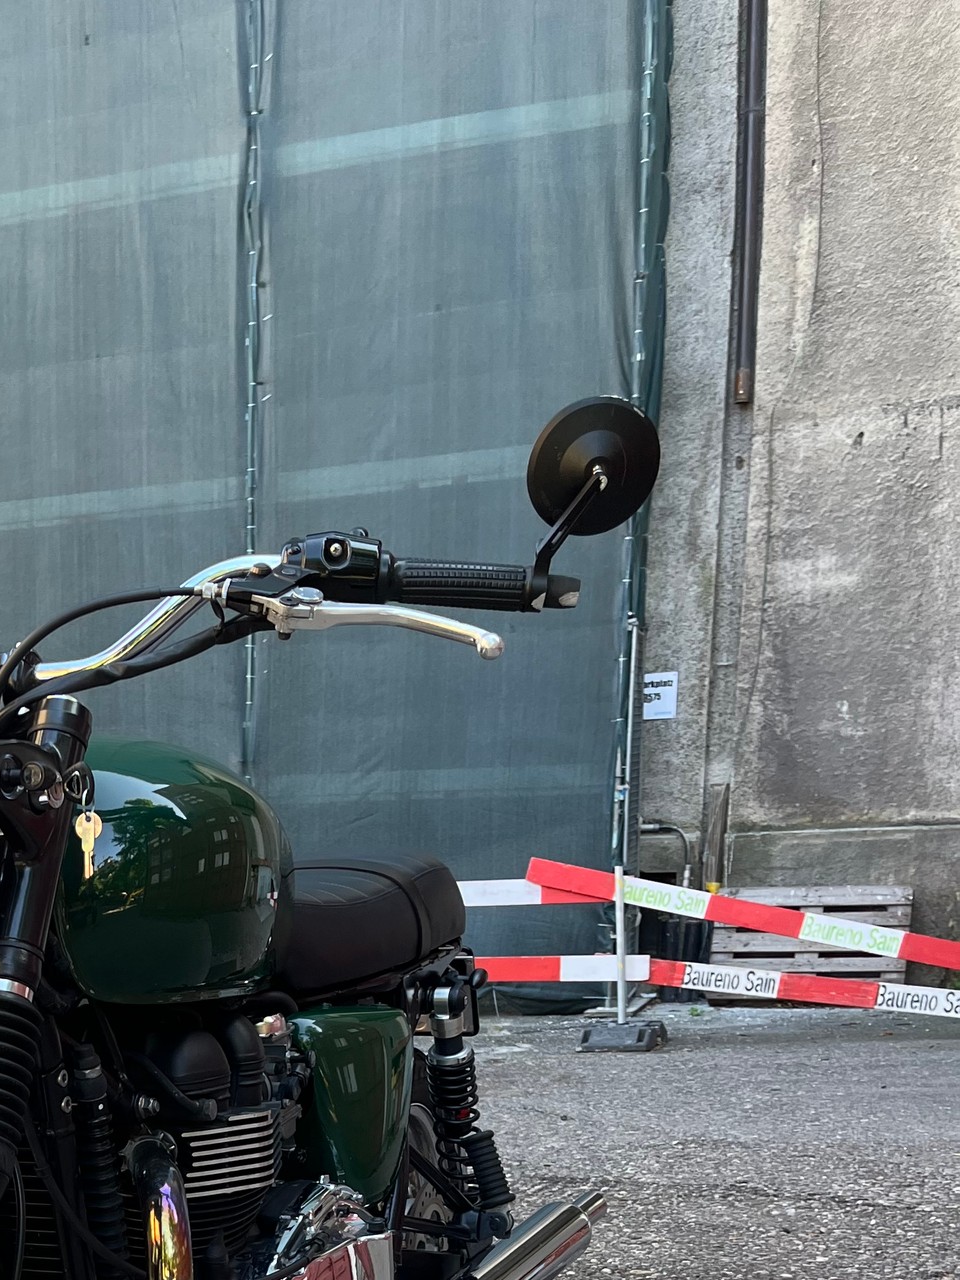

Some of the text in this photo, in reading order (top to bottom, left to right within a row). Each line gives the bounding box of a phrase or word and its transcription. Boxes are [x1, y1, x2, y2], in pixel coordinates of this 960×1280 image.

[674, 890, 706, 914] Sain
[800, 913, 901, 953] Baureno Sain
[683, 964, 776, 995] Baureno Sain
[876, 984, 960, 1014] Baureno Sa
